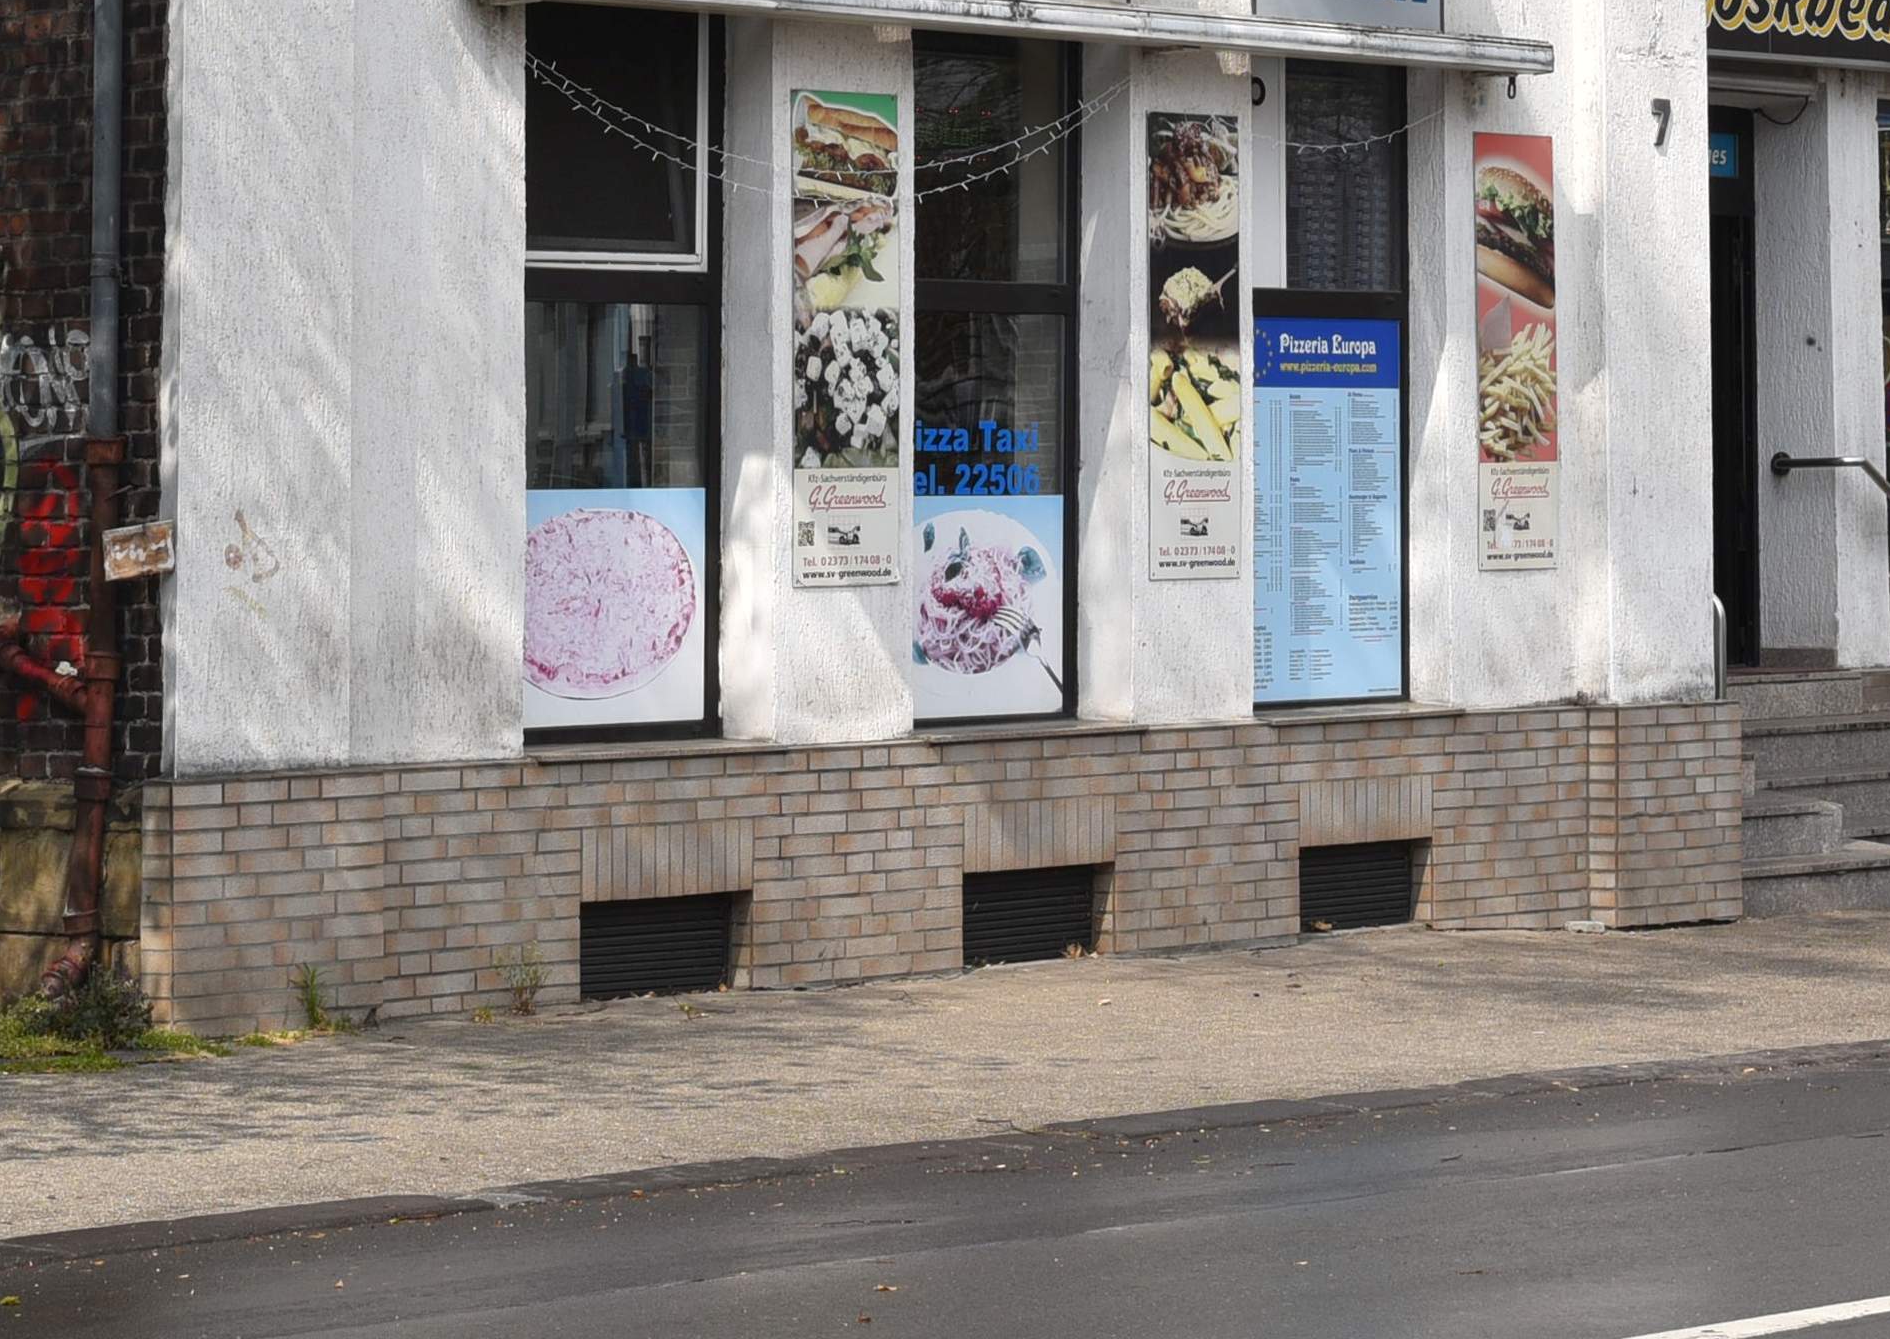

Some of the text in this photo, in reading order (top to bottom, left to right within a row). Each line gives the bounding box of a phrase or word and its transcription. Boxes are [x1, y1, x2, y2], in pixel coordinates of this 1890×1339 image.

[1651, 98, 1672, 147] 7
[1279, 333, 1377, 359] Pizzeria Europa
[915, 419, 1040, 452] izza Taxi
[914, 463, 1040, 495] el. 22506
[803, 557, 817, 567] Tel.
